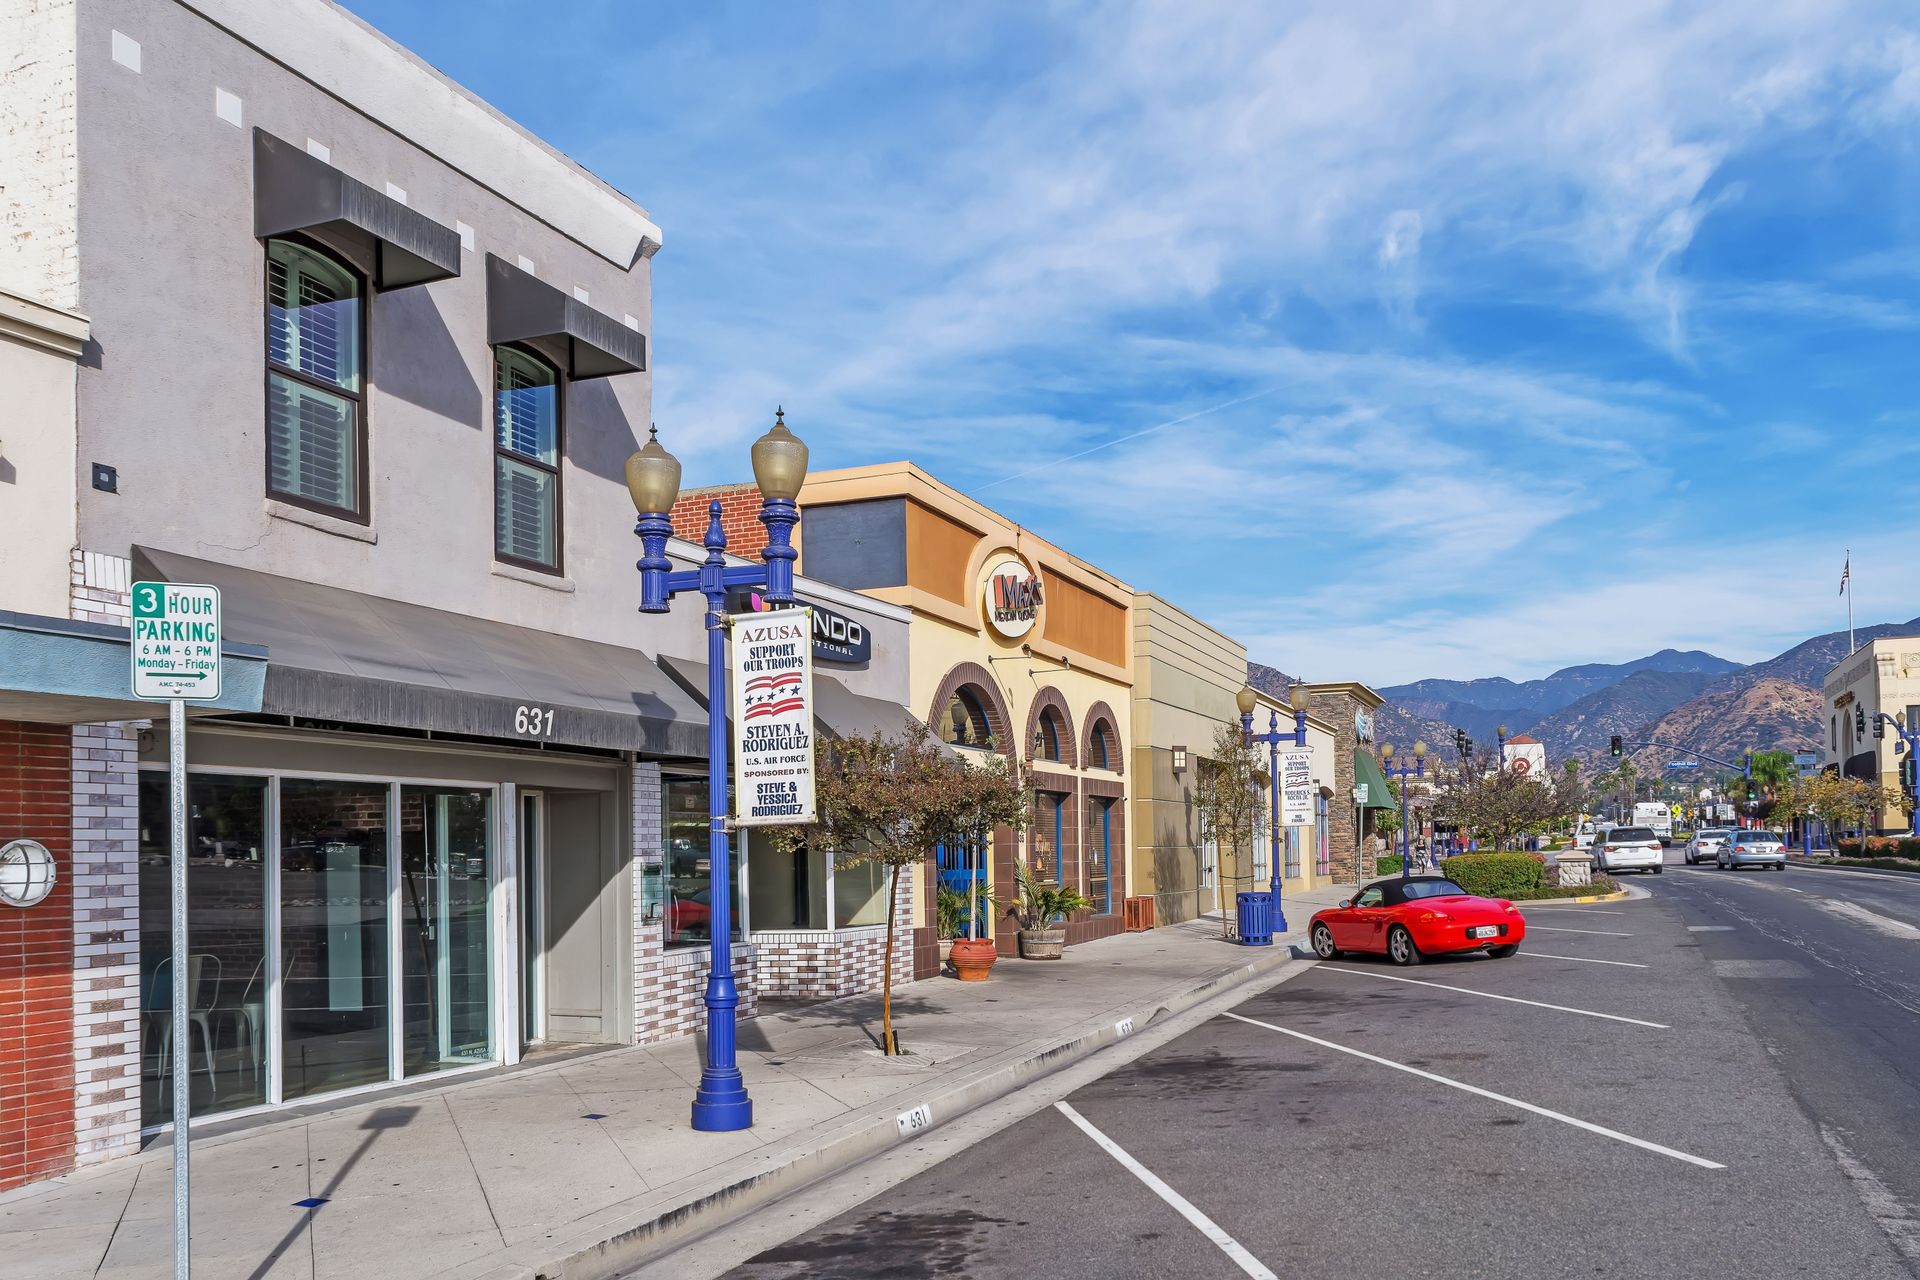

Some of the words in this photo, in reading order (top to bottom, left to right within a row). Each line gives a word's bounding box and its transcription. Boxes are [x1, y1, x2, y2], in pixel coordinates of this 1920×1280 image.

[139, 588, 158, 613] 3
[169, 595, 212, 615] HOUR
[136, 619, 216, 642] PARKING
[741, 625, 803, 644] AZUSA
[813, 610, 862, 646] NDO
[142, 644, 150, 655] 6
[154, 645, 171, 655] AM
[184, 646, 191, 656] 6
[196, 646, 212, 657] PM
[749, 643, 796, 660] SUPPORT
[137, 657, 176, 671] Monday
[185, 659, 216, 672] Friday
[743, 658, 764, 672] OUR
[765, 656, 804, 671] TROOPS
[515, 705, 554, 736] 631
[746, 723, 792, 739] STEVEN
[793, 722, 805, 735] A.
[742, 735, 809, 753] RODRIGUEZ
[746, 757, 762, 766] U.S.
[764, 756, 778, 765] AIR
[779, 754, 806, 764] FORCE
[744, 769, 795, 778] SPONSORED
[756, 782, 787, 794] STEVE
[788, 781, 798, 792] &
[757, 793, 797, 805] YESSICA
[751, 804, 803, 817] RODRIGUEZ
[910, 1108, 927, 1129] 631
